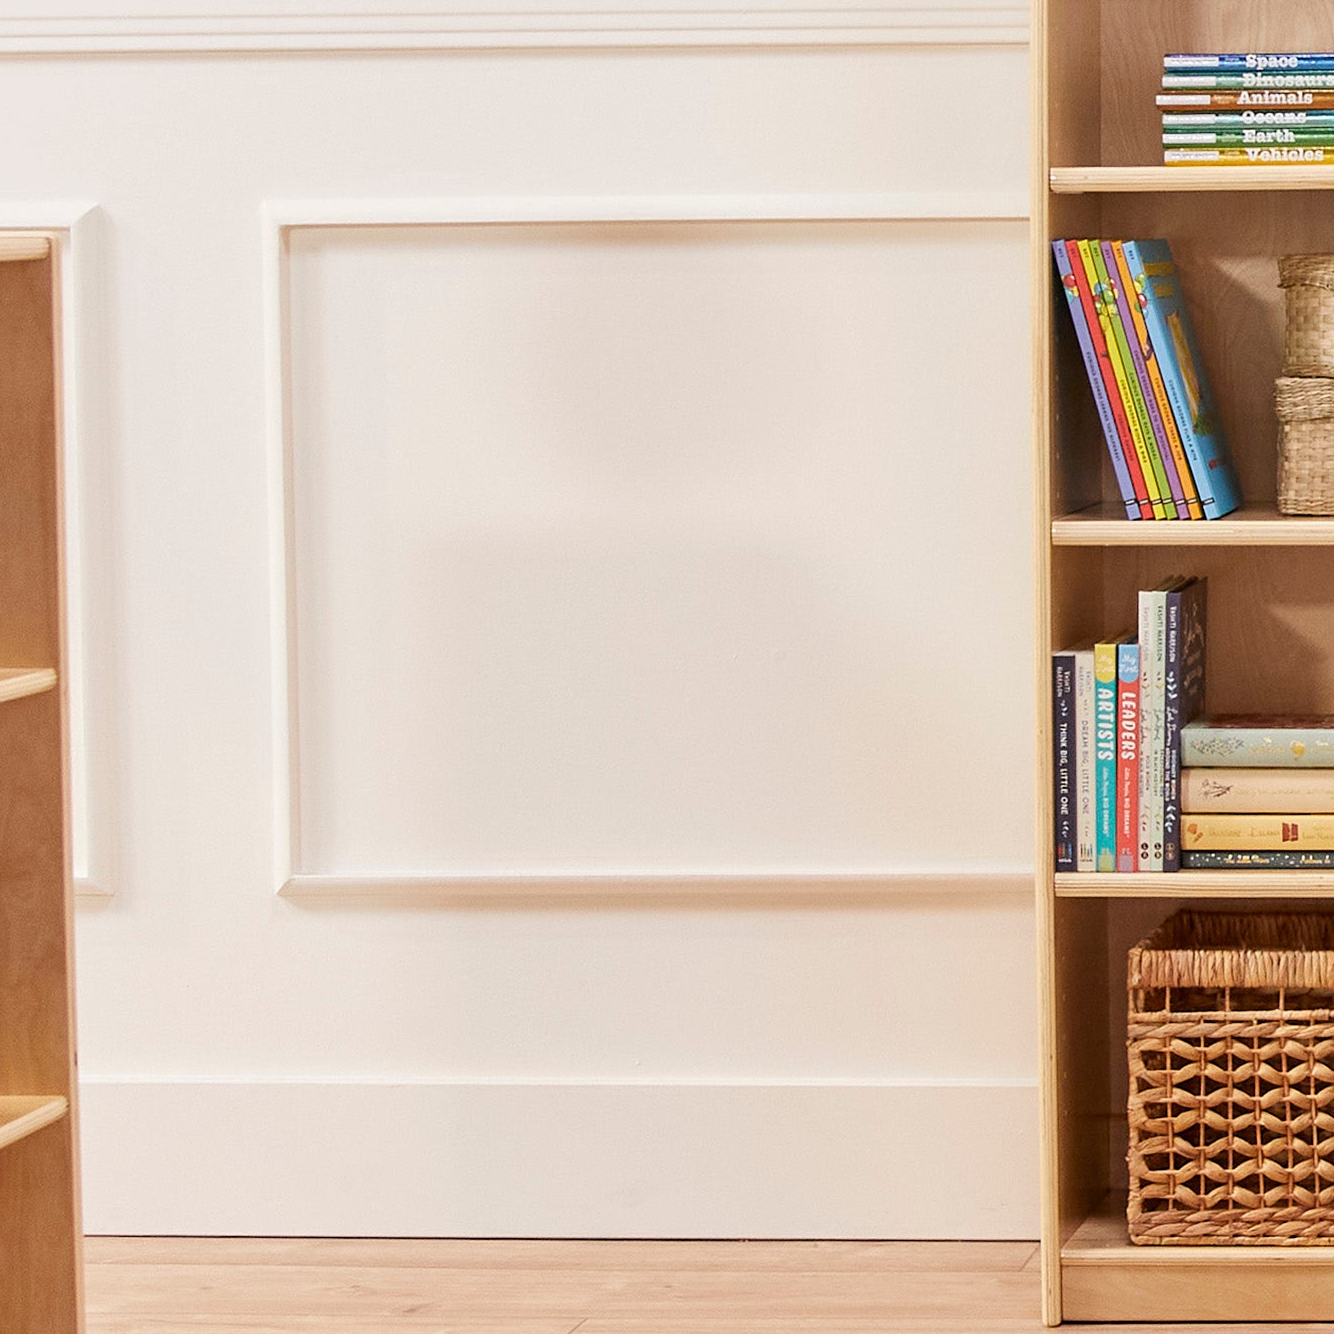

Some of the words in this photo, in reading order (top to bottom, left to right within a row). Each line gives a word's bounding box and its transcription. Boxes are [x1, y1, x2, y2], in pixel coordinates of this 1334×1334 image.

[1246, 54, 1298, 70] Space
[1243, 73, 1334, 87] Dinosaurs
[1237, 91, 1313, 104] Animals
[1242, 111, 1306, 124] Oceans
[1243, 129, 1295, 143] Earth
[1246, 148, 1323, 161] Vehicles
[1098, 688, 1113, 760] ARTISTS
[1121, 692, 1136, 760] LEADERS
[1060, 769, 1068, 794] LITTLE
